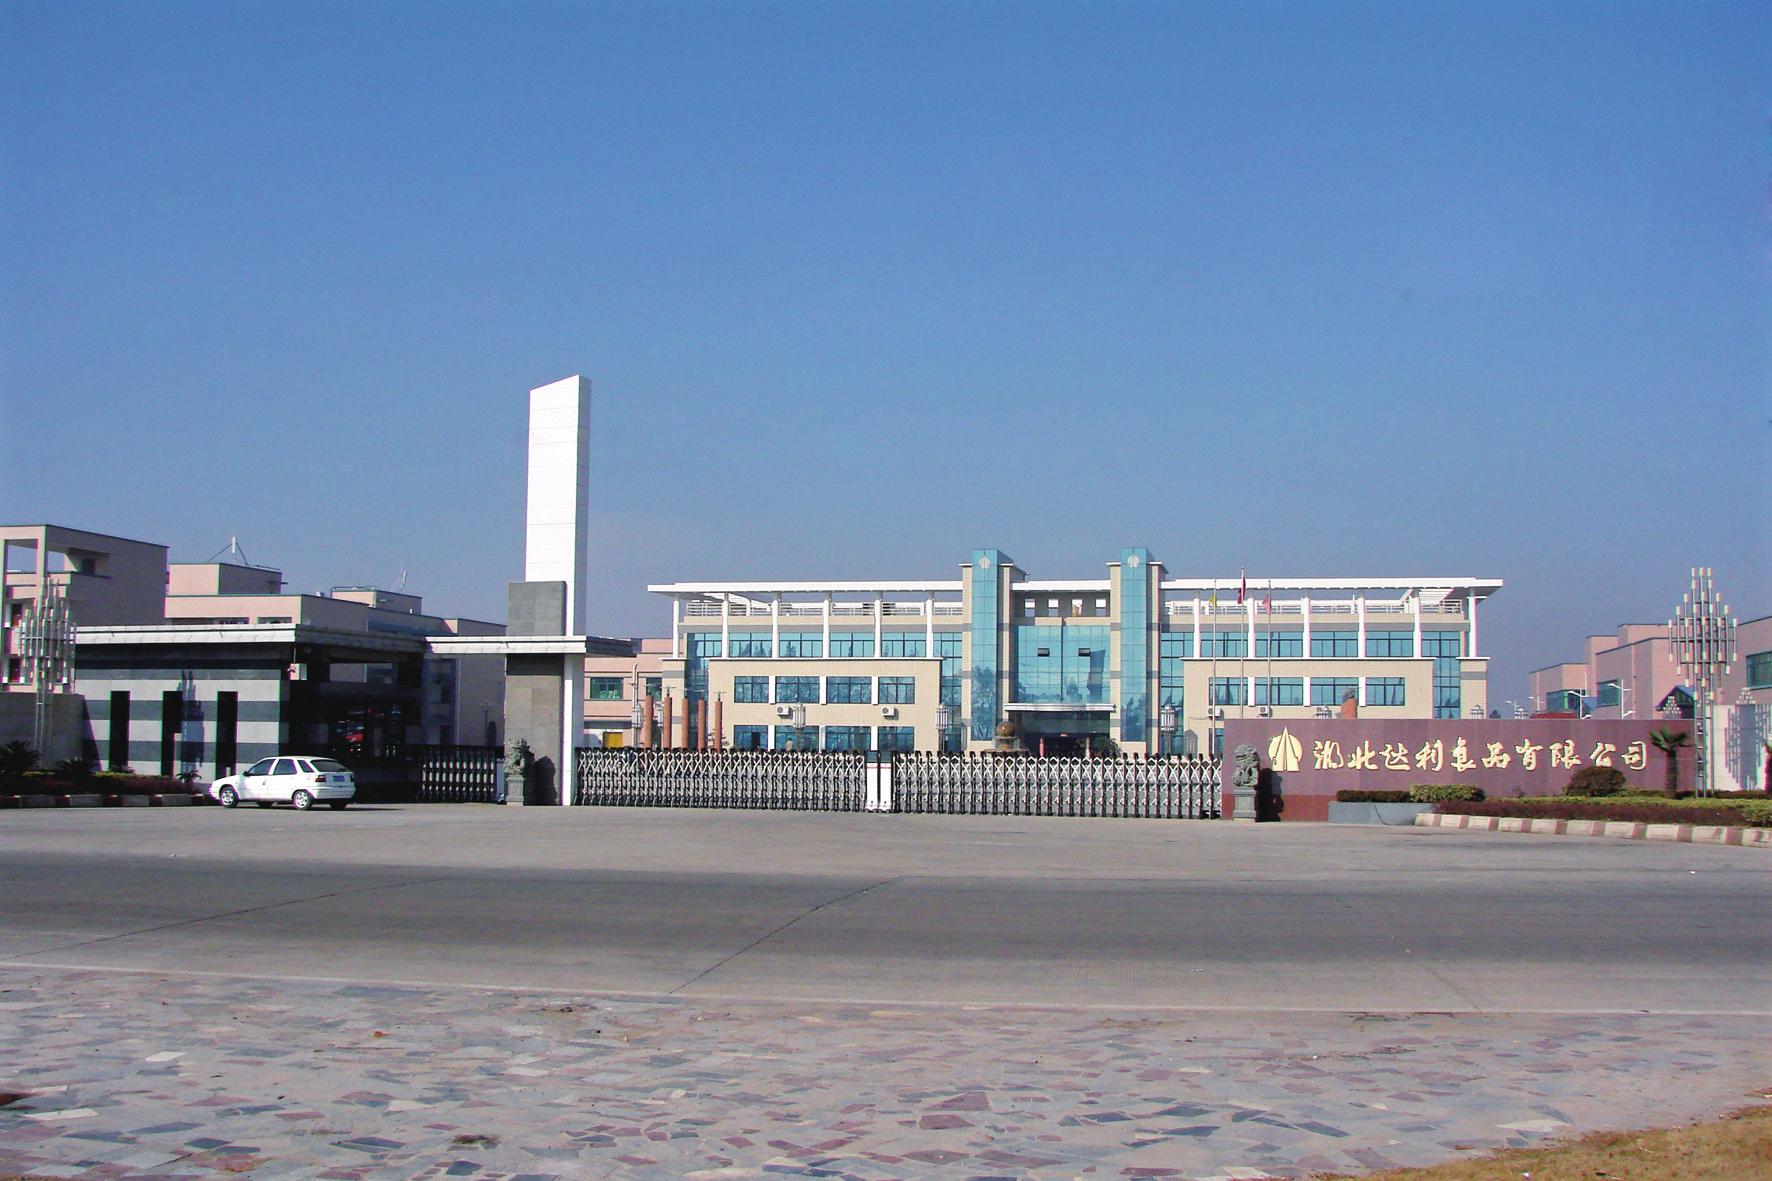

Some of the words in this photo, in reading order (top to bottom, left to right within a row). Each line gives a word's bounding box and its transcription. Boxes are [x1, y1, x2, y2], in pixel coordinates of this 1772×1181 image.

[1313, 738, 1647, 771] 湖北达利食品有限公司
